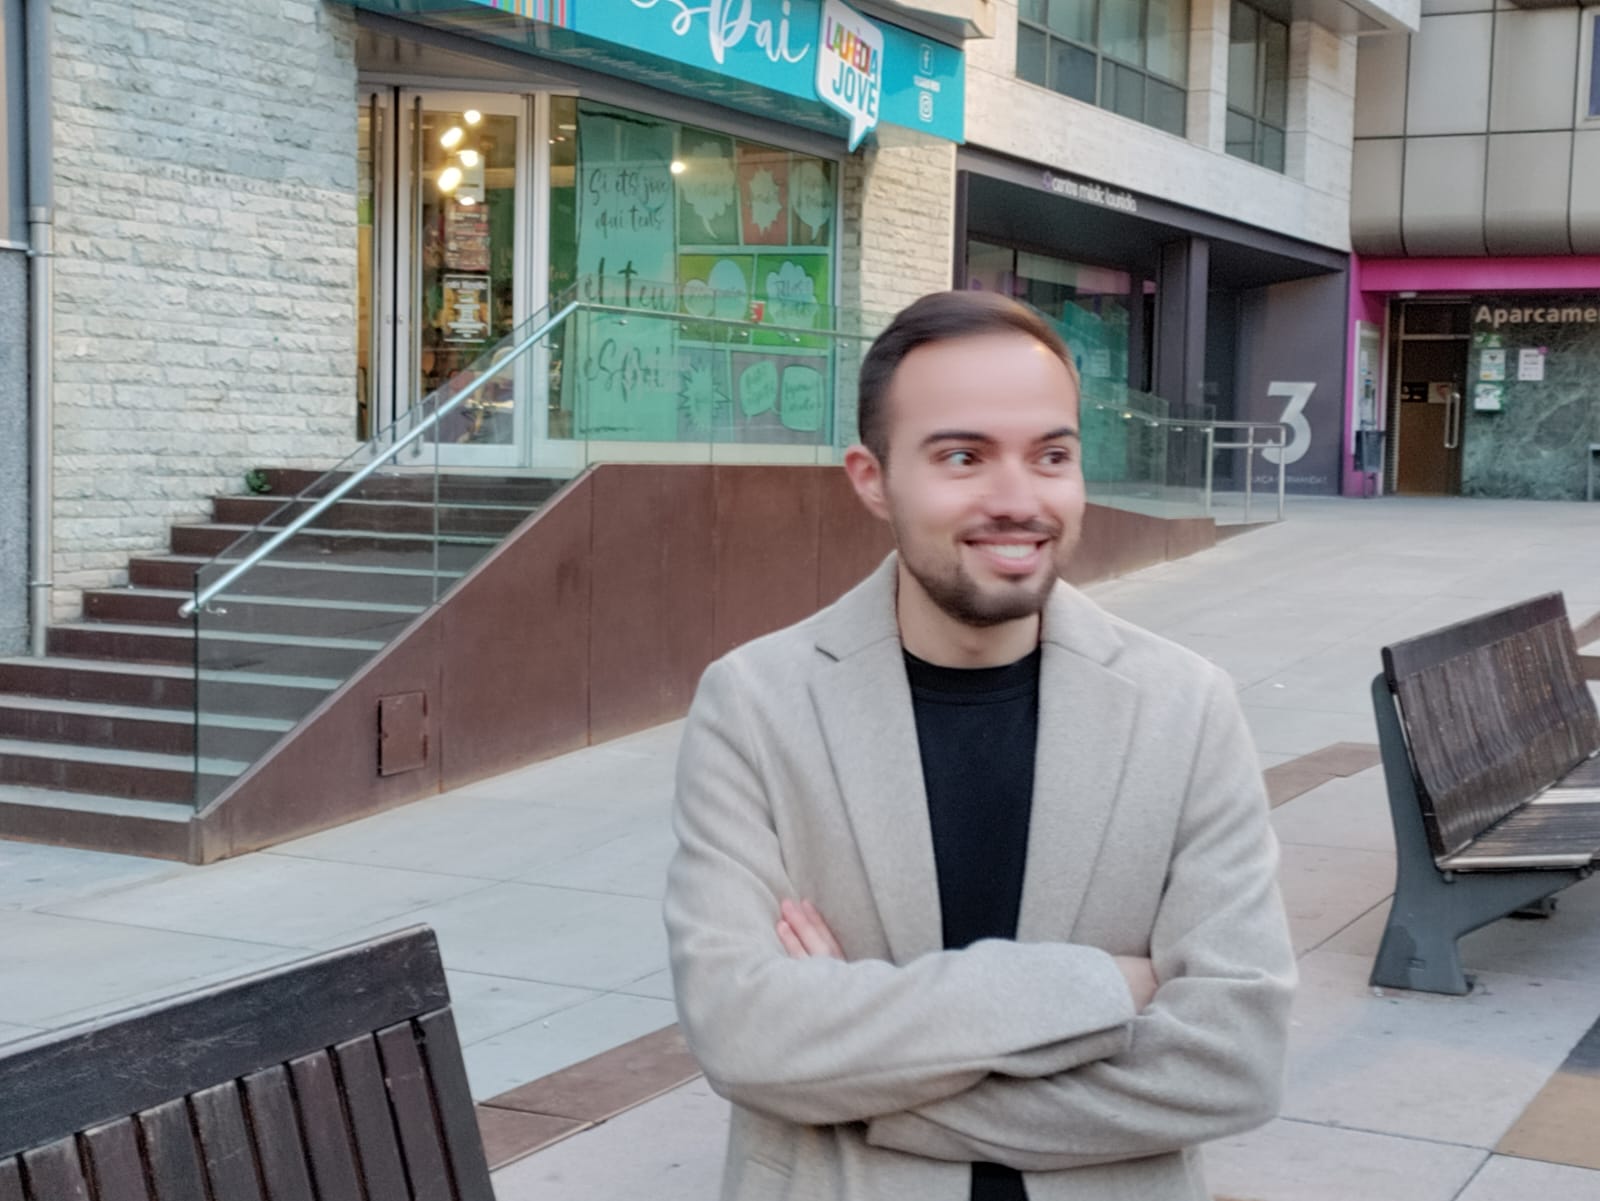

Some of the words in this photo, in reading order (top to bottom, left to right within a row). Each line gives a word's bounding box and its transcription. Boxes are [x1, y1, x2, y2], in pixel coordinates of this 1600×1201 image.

[831, 63, 878, 119] JOVE
[1474, 304, 1600, 329] Aparcame
[1261, 381, 1317, 465] 3
